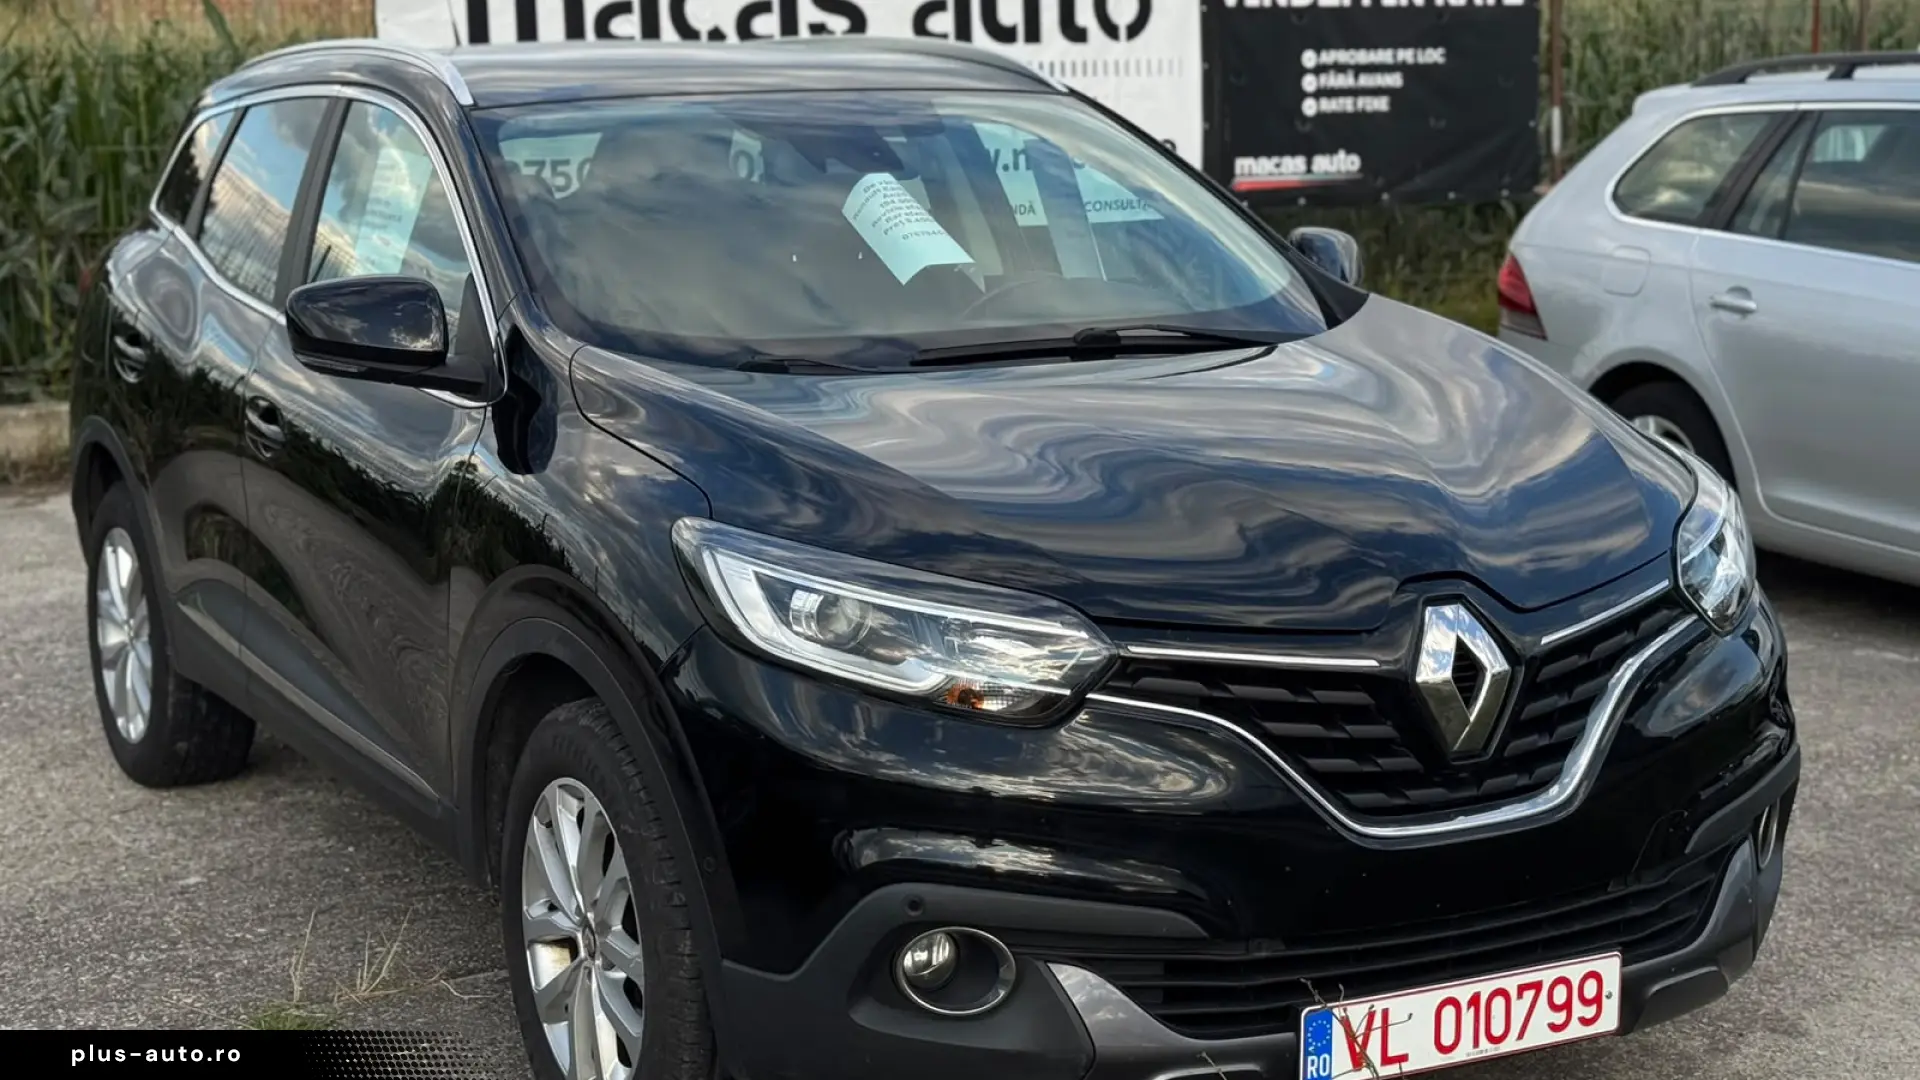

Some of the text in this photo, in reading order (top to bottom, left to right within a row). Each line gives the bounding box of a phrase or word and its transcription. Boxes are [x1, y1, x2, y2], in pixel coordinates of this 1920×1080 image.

[1317, 47, 1446, 65] APROBARE PE LOC
[1356, 71, 1404, 88] AVANS
[1317, 95, 1390, 113] RATE FIXE
[1234, 149, 1361, 175] macas auto
[1340, 970, 1604, 1073] VL 010799
[1307, 1053, 1330, 1079] RO
